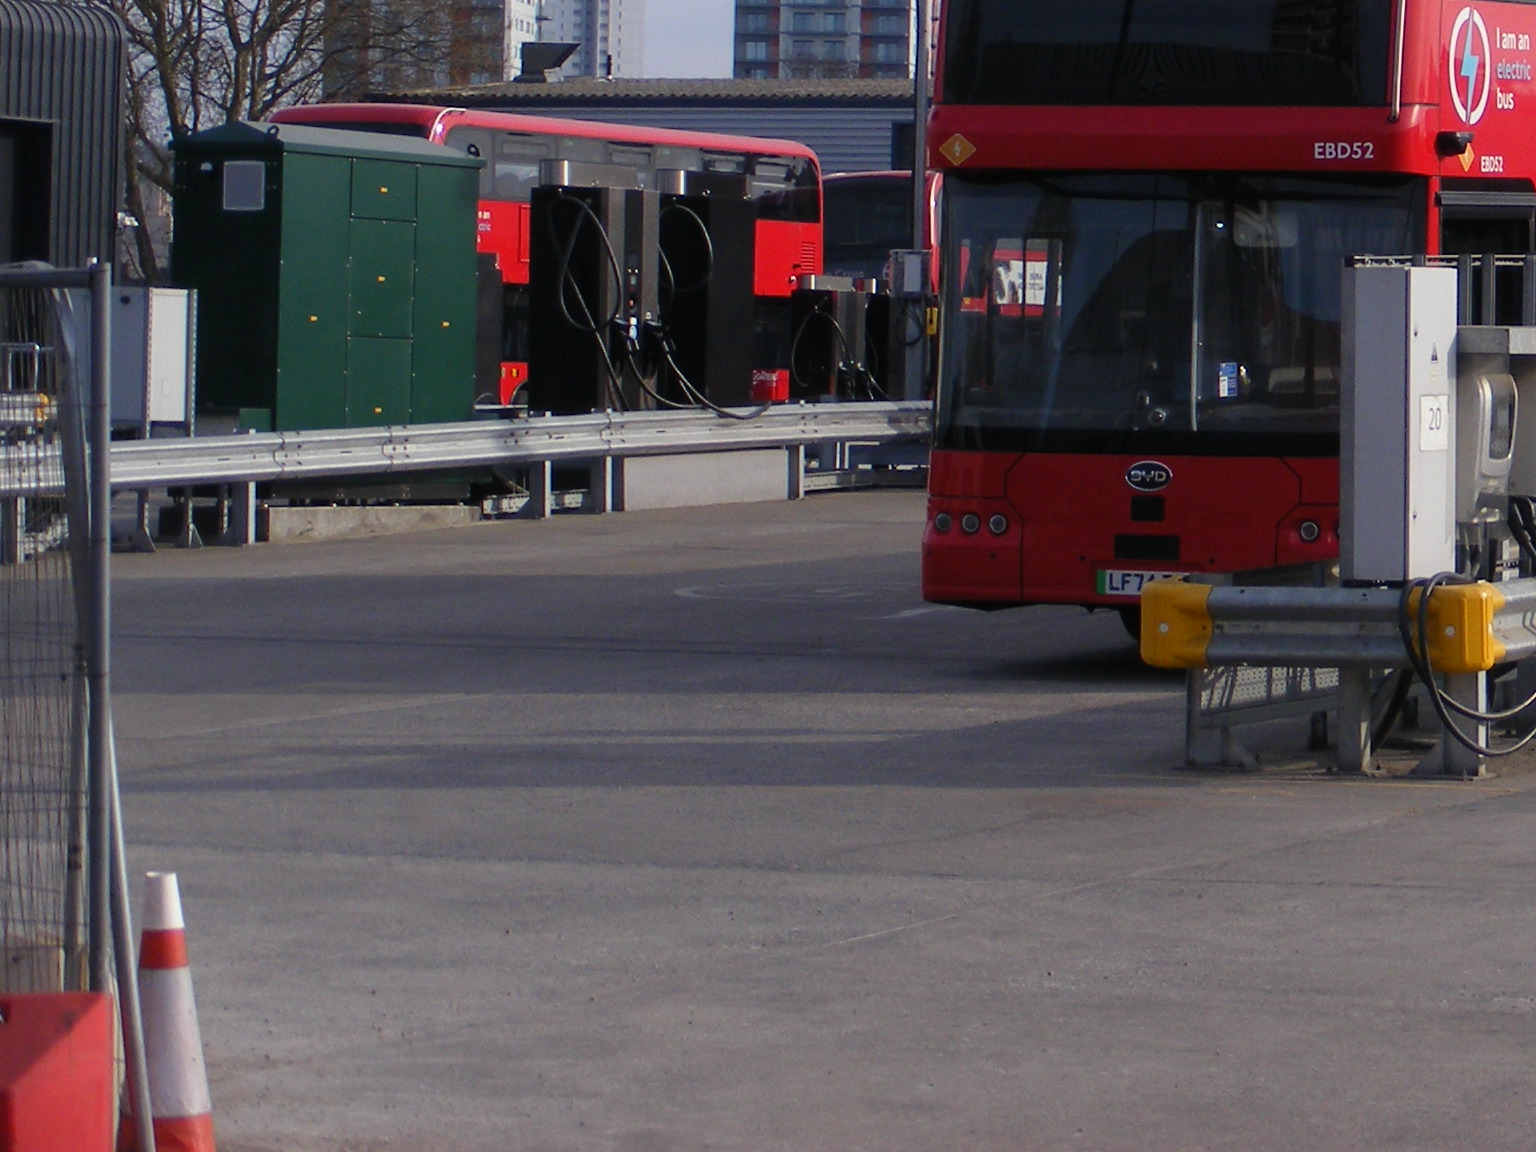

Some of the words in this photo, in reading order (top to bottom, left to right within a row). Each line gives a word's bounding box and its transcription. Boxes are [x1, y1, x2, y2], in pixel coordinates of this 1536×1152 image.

[1496, 27, 1501, 49] I
[1502, 35, 1517, 50] am
[1518, 34, 1530, 51] an
[1496, 58, 1532, 80] electric
[1496, 88, 1515, 109] bus
[1314, 142, 1374, 159] EBD52
[1480, 156, 1504, 172] EBD52
[1428, 407, 1442, 431] 20
[1130, 470, 1167, 482] BYD
